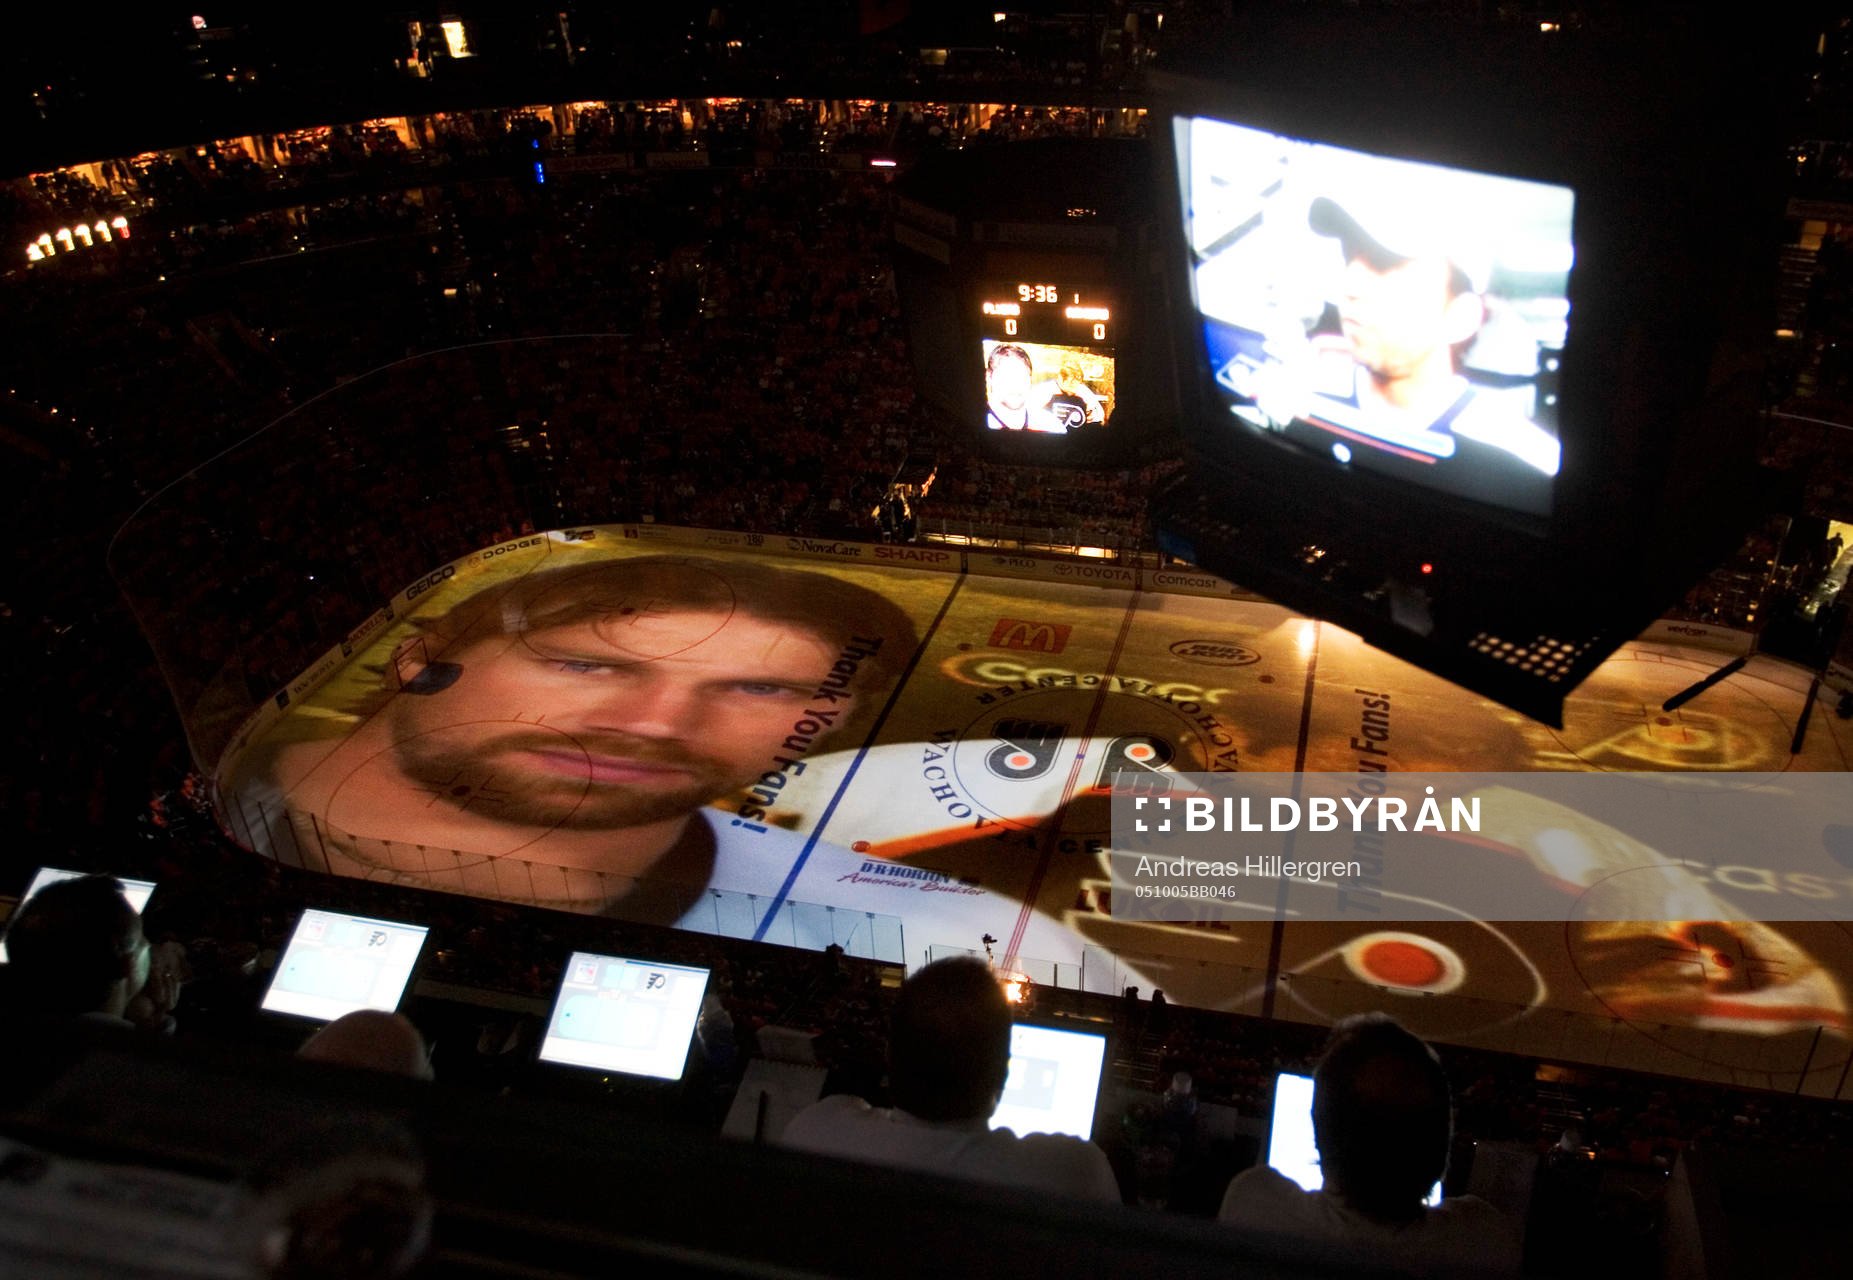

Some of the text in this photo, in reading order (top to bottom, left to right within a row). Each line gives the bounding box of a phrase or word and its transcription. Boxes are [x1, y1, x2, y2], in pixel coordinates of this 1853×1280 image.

[1018, 284, 1058, 303] 9:36
[1005, 319, 1017, 335] 0
[1093, 323, 1106, 340] 0
[483, 537, 542, 560] DODGE
[801, 540, 861, 558] NovaCare
[874, 547, 949, 564] SHARP
[406, 565, 455, 601] GEICO
[1074, 566, 1133, 583] TOYOTA
[976, 674, 1099, 705] CENTER
[1351, 687, 1391, 757] Fans!
[730, 635, 885, 834] Thank You Fans!
[921, 728, 1037, 850] WACHOVIA
